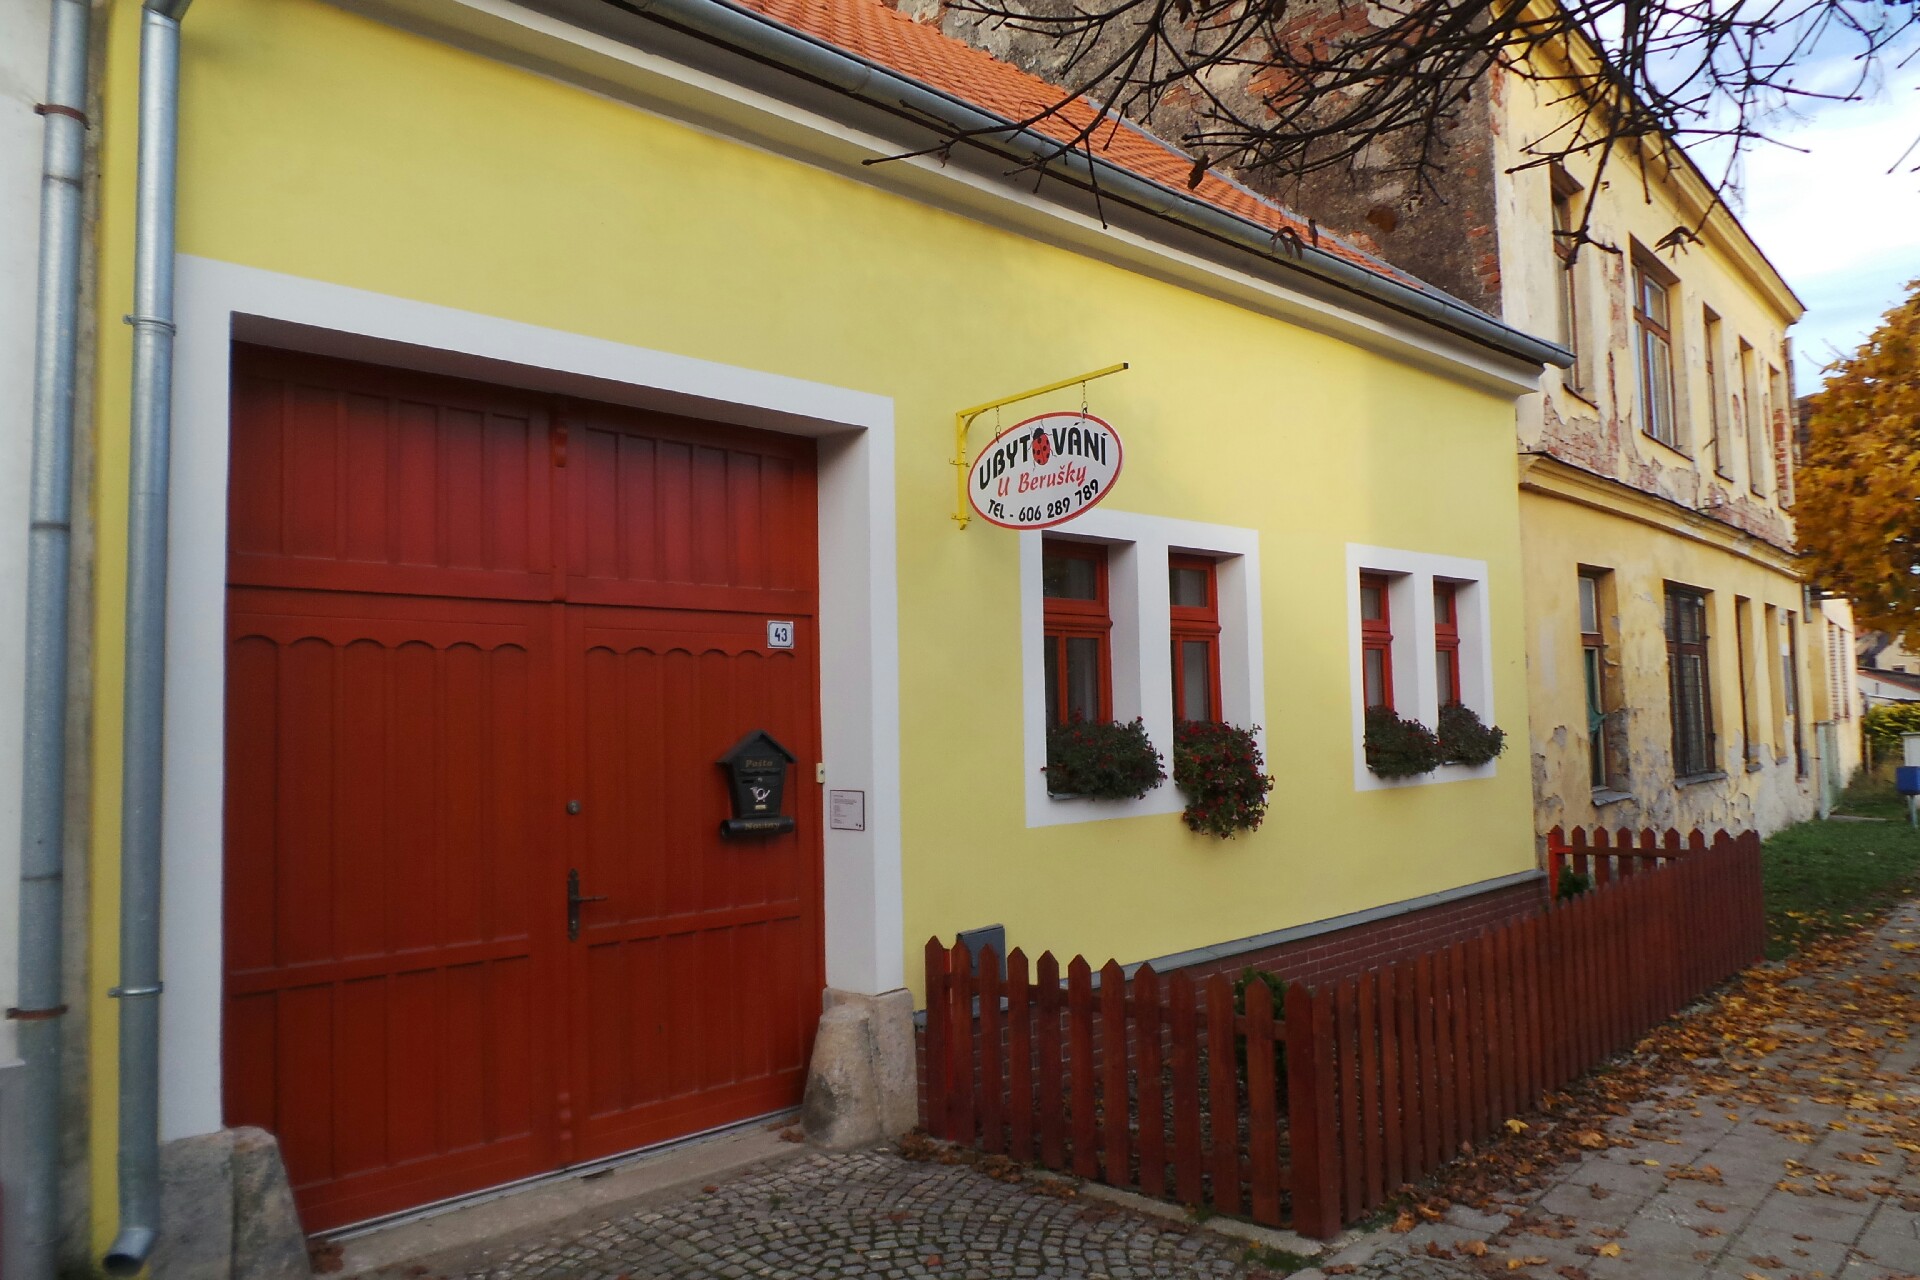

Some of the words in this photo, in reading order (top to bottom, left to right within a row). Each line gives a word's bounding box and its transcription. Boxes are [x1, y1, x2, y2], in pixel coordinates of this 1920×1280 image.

[997, 475, 1010, 498] U
[1018, 461, 1087, 494] Berušky
[988, 499, 1005, 520] TEL
[1018, 505, 1042, 522] 606
[1047, 497, 1070, 518] 289
[1074, 478, 1099, 506] 789
[774, 627, 788, 642] 43
